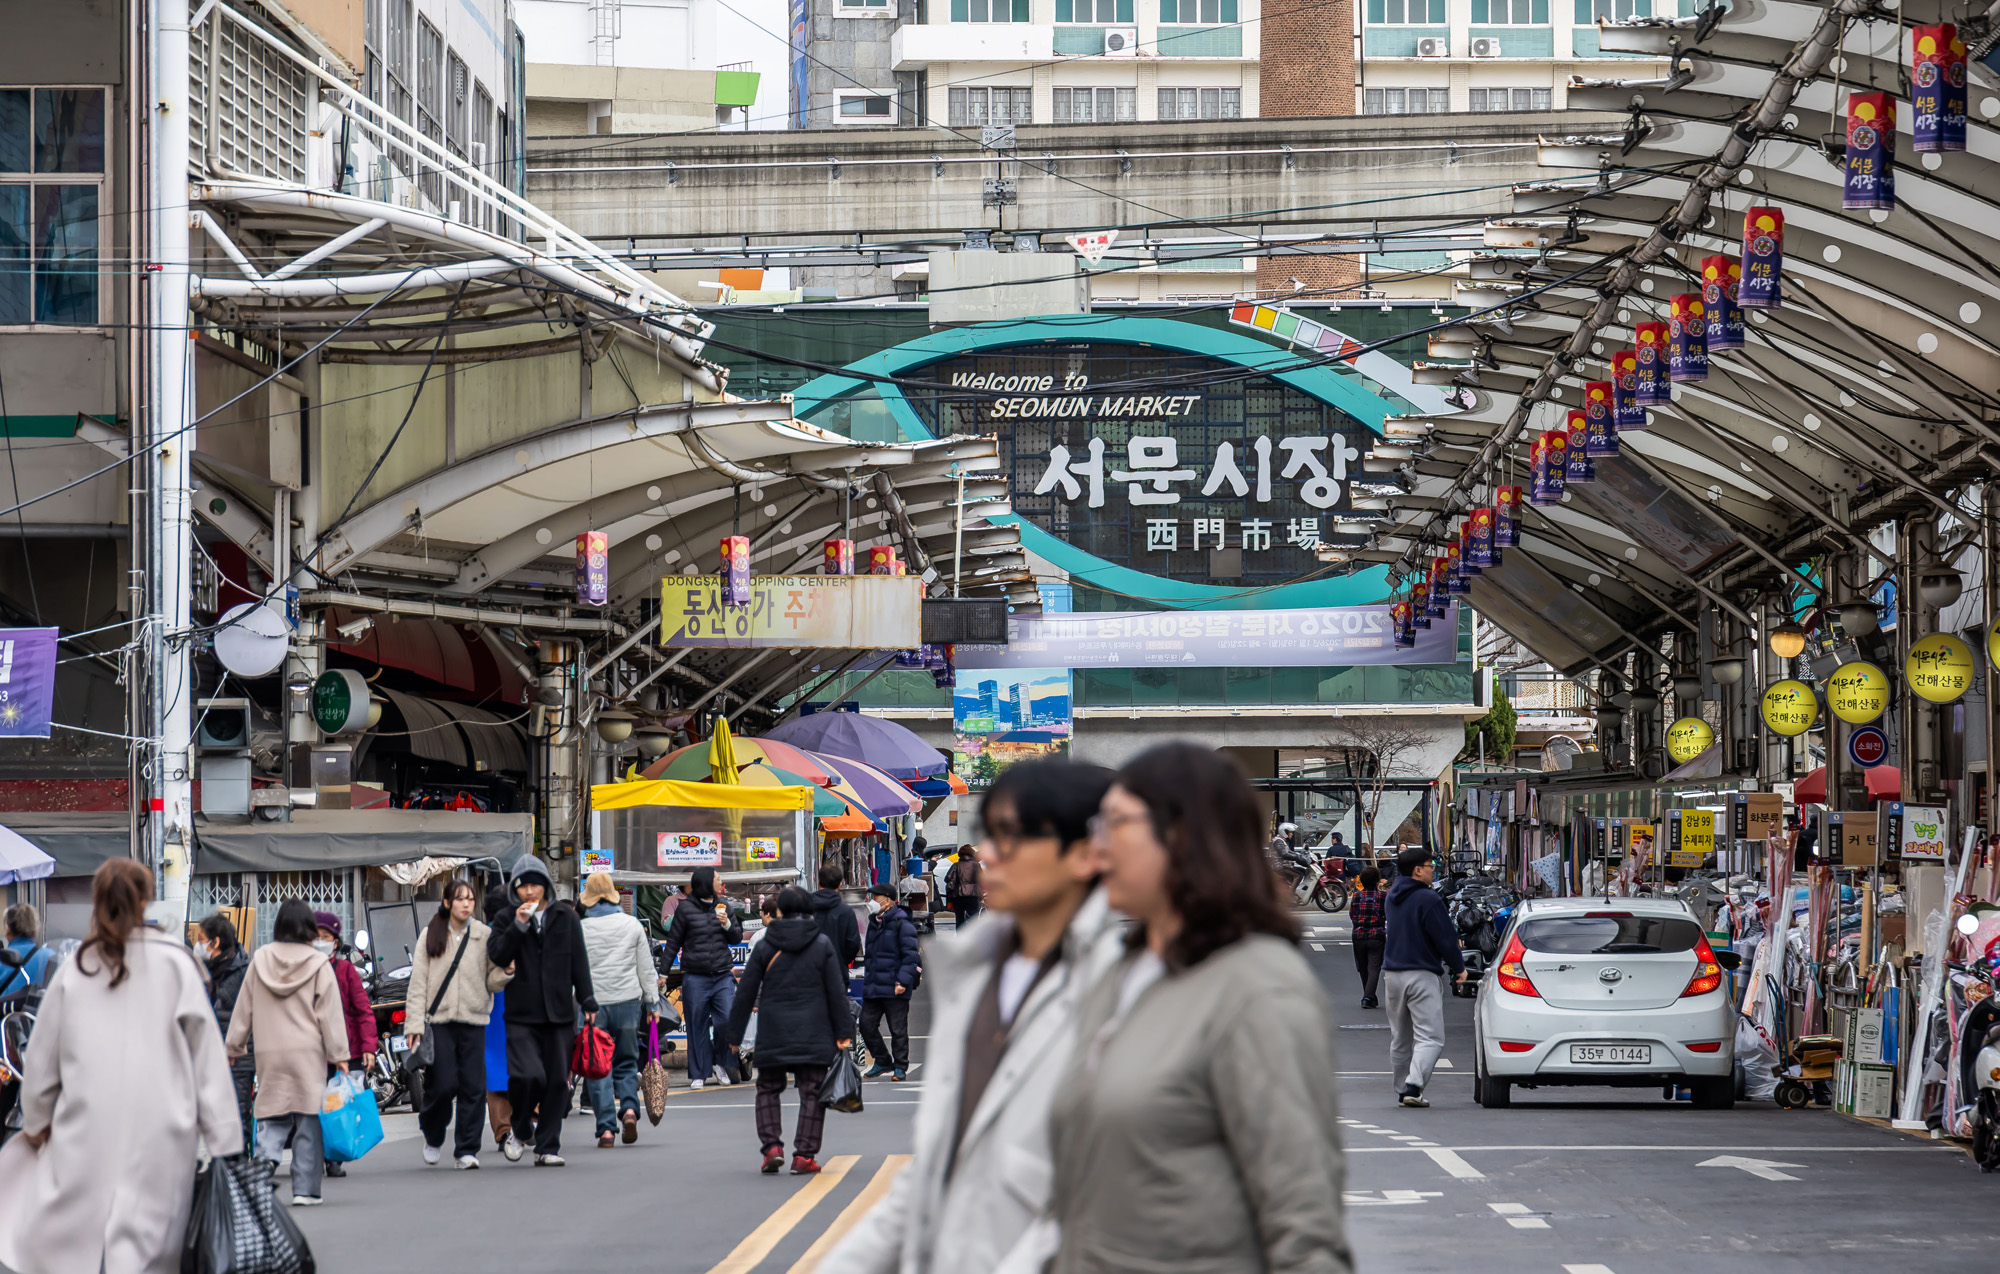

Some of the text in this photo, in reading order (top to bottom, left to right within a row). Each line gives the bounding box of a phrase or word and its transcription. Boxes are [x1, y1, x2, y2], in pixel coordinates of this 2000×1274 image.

[1916, 96, 1939, 114] 서문
[1915, 114, 1941, 129] 시장
[1850, 157, 1878, 174] 서문
[1850, 174, 1877, 190] 시장
[1750, 262, 1776, 277] 서문
[1750, 277, 1775, 291] 시장
[1707, 310, 1721, 323] 서문
[1708, 323, 1723, 335] 시장
[1688, 344, 1703, 355] 서문
[1684, 354, 1708, 365] 야시장
[951, 371, 1089, 392] Welcome to
[1638, 369, 1656, 381] 서문
[1638, 381, 1656, 392] 시장
[990, 395, 1201, 418] SEOMUN MARKET
[1589, 424, 1607, 435] 서문
[1589, 435, 1607, 445] 시장
[1570, 451, 1586, 462] 서문
[1033, 432, 1359, 509] 서문시장
[1570, 462, 1587, 472] 시장
[1549, 479, 1564, 488] 시장
[1146, 518, 1322, 552] 西門市場
[667, 576, 847, 588] DONGSA OPPING CENTER
[1914, 673, 1965, 688] 건해산물
[1836, 698, 1881, 710] 건해산물
[1769, 712, 1810, 725] 건해산물
[319, 720, 354, 735] 동산상가
[1857, 742, 1881, 751] 소화전
[1685, 815, 1711, 828] 강남 99
[1750, 813, 1780, 823] 화분류
[1683, 834, 1712, 847] 수제피자
[1578, 1047, 1643, 1061] 35부 0144
